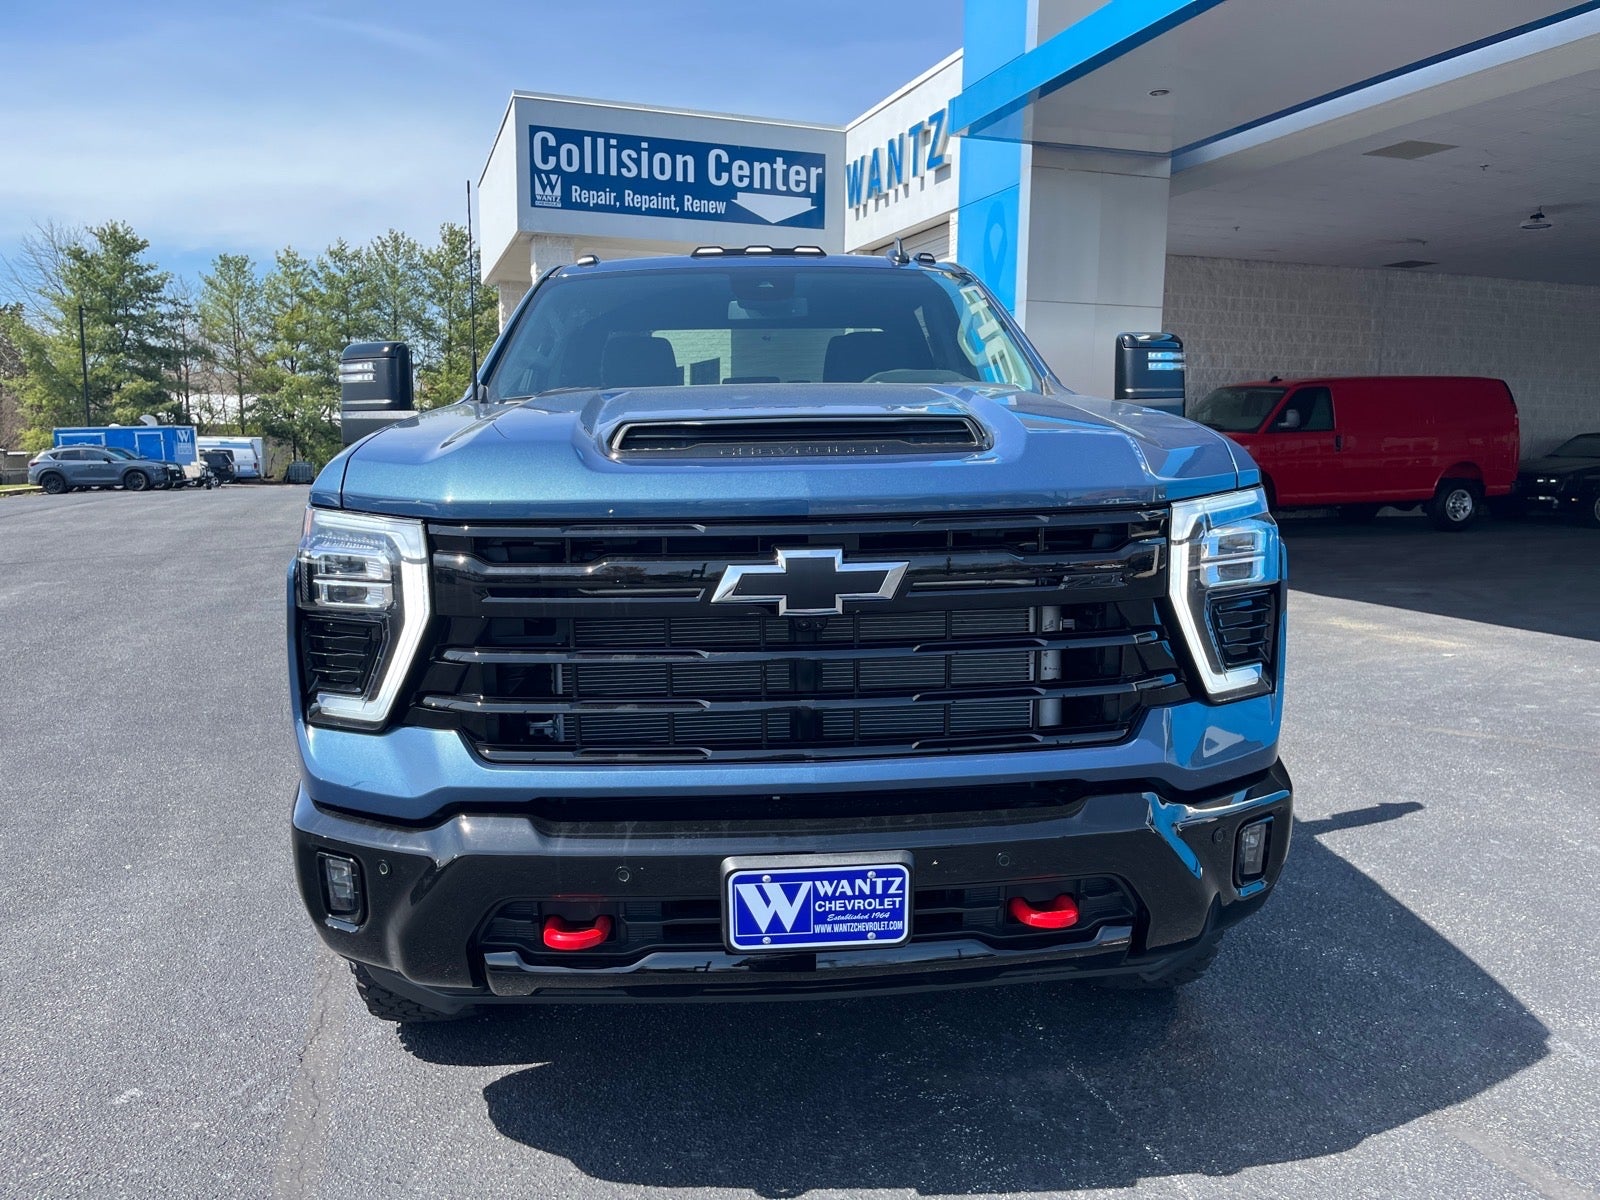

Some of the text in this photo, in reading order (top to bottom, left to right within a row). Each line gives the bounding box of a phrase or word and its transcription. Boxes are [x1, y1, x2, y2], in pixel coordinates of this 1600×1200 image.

[533, 131, 822, 194] Collision Center
[846, 107, 949, 209] WANTZ
[535, 174, 561, 195] W
[535, 194, 562, 203] WANTZ
[571, 186, 726, 214] Repair, Repaint, Renew
[814, 876, 904, 897] WANTZ
[736, 882, 812, 934] W
[815, 897, 903, 912] CHEVROLET
[827, 911, 890, 921] Established 1964
[814, 920, 903, 934] WWW.WANTZCHEVROLET.COM
